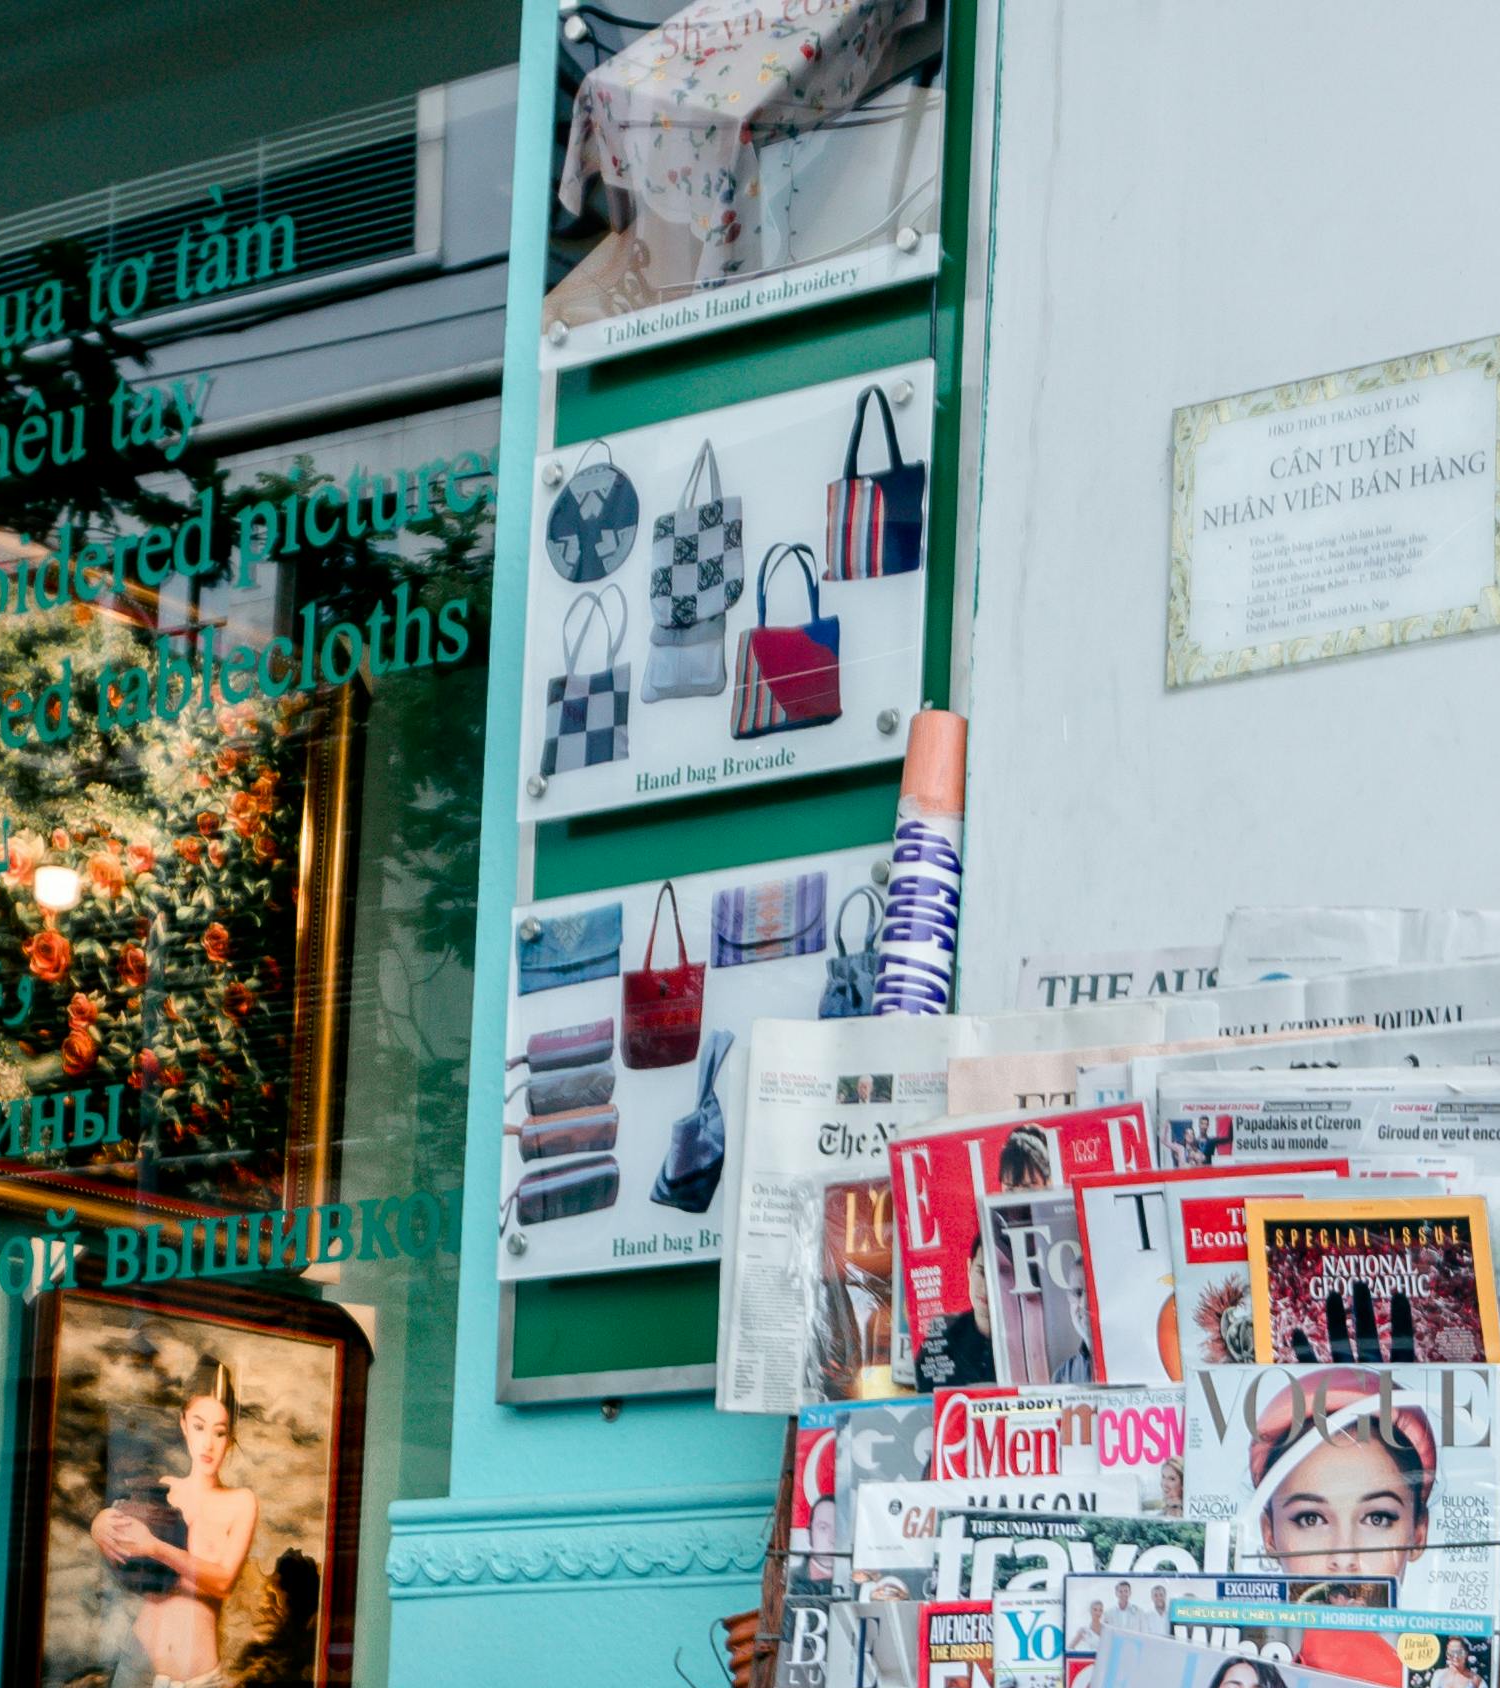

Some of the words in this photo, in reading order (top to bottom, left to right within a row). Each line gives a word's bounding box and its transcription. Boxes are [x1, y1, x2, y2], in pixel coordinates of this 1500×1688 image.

[90, 248, 156, 324] tơ
[604, 300, 700, 346] Tablecloths
[705, 289, 751, 319] Hand
[756, 265, 860, 306] embroidery
[1330, 407, 1373, 427] TRANG
[1395, 392, 1421, 411] LAN
[110, 370, 211, 474] tay
[1202, 495, 1277, 531] NHÂN
[1283, 481, 1344, 514] VIÊN
[1351, 467, 1403, 499] BÁN
[1409, 450, 1487, 489] HÀNG
[96, 583, 469, 728] tablecloths
[635, 764, 683, 796] Hand
[685, 760, 718, 789] bag
[721, 746, 798, 779] Brocade
[1236, 1115, 1298, 1133] Papadakis
[1300, 1116, 1314, 1131] et
[1315, 1114, 1362, 1131] Cizeron
[1378, 1124, 1420, 1142] Giroud
[1422, 1127, 1439, 1141] en
[1441, 1126, 1471, 1142] veut
[818, 1121, 867, 1160] The
[1236, 1136, 1268, 1151] seuls
[1271, 1138, 1285, 1151] au
[1288, 1136, 1329, 1151] monde
[612, 1235, 659, 1259] Hand
[662, 1232, 694, 1256] bag
[1275, 1227, 1371, 1249] SPECIAL
[1389, 1225, 1460, 1246] ISSUE
[1321, 1253, 1419, 1277] NATIONAL
[972, 1398, 1049, 1414] TOTAL-BODY
[1196, 1366, 1492, 1449] VOGUE
[1188, 1502, 1238, 1516] NAOMI
[1443, 1507, 1490, 1519] DOLLAR
[970, 1519, 1000, 1536] THE
[1000, 1520, 1047, 1537] SUNDAY
[1045, 1521, 1088, 1537] TIMES
[1436, 1519, 1490, 1531] FASHION
[1428, 1570, 1490, 1584] SPRING'S
[1224, 1581, 1280, 1597] EXCLUSIVE
[1458, 1584, 1489, 1597] BEST
[1449, 1597, 1489, 1610] BAGS
[1241, 1607, 1276, 1621] CHRIS
[1278, 1609, 1318, 1624] WATTS
[1320, 1611, 1377, 1627] HORRIFIC
[1379, 1614, 1407, 1629] NEW
[1408, 1616, 1485, 1633] CONFESSION
[930, 1644, 949, 1660] THE
[950, 1644, 984, 1660] RUSSO
[1403, 1637, 1432, 1650] Bride
